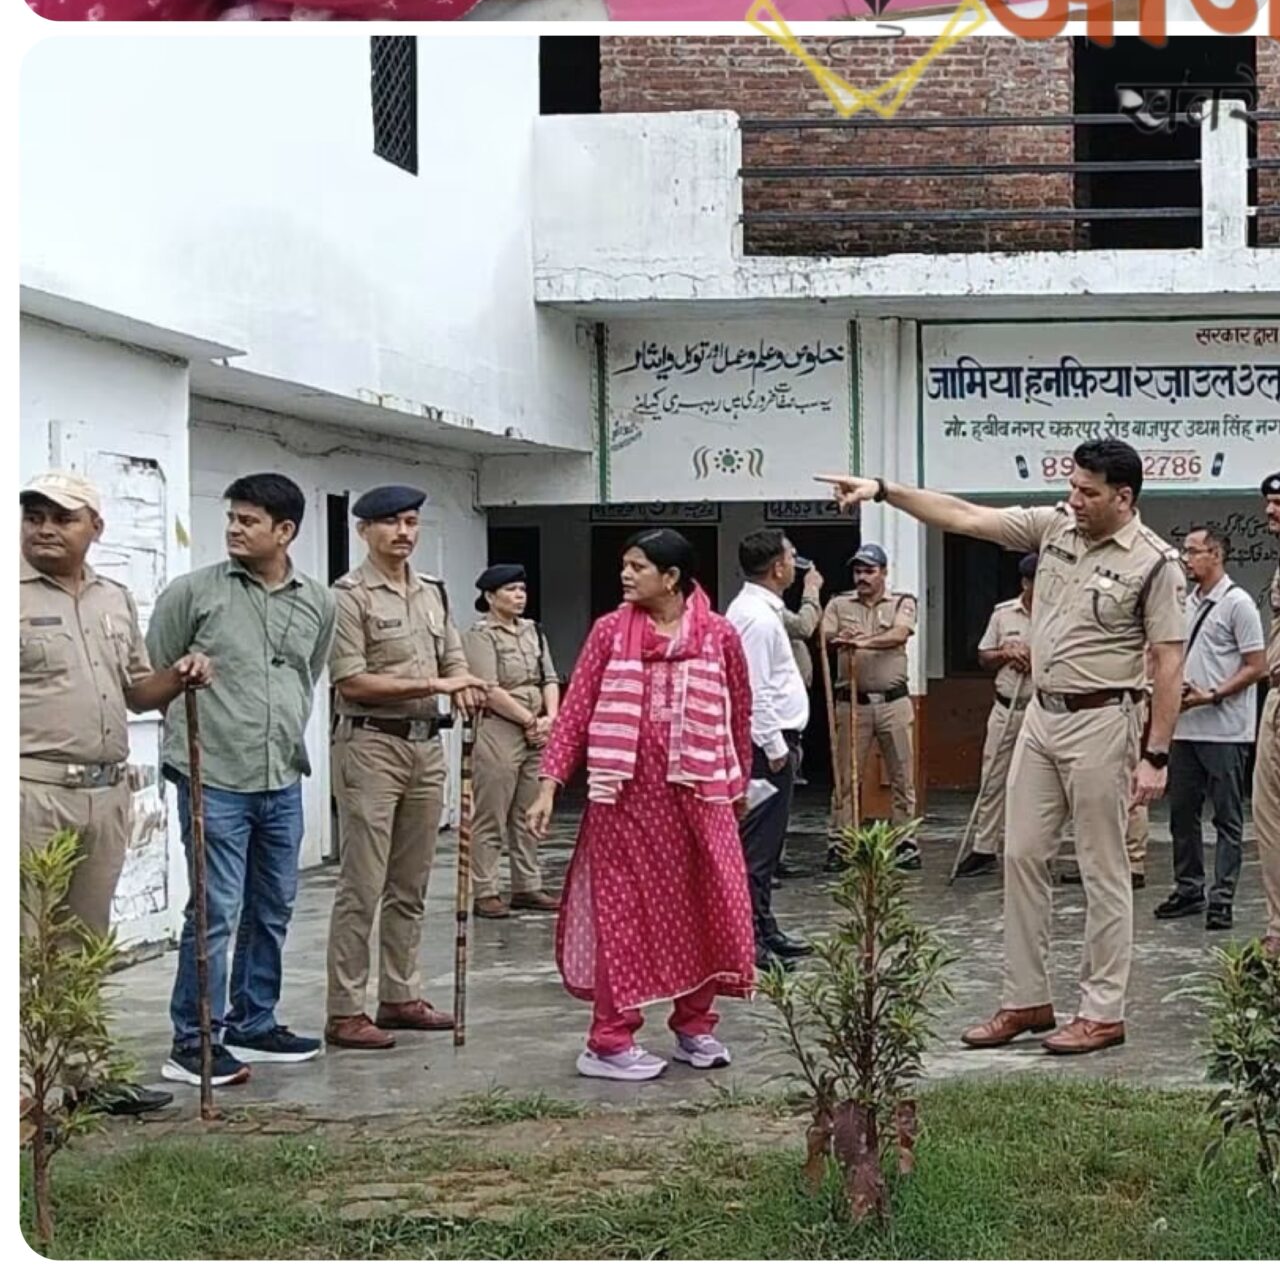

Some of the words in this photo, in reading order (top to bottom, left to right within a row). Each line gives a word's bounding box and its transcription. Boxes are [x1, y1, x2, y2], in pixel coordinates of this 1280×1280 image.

[1195, 326, 1251, 346] सरकार
[1253, 326, 1279, 347] द्वारा
[927, 355, 1024, 400] जामिया
[1010, 419, 1046, 439] नगर
[1222, 413, 1254, 441] सिंह
[1041, 455, 1202, 478] 892786
